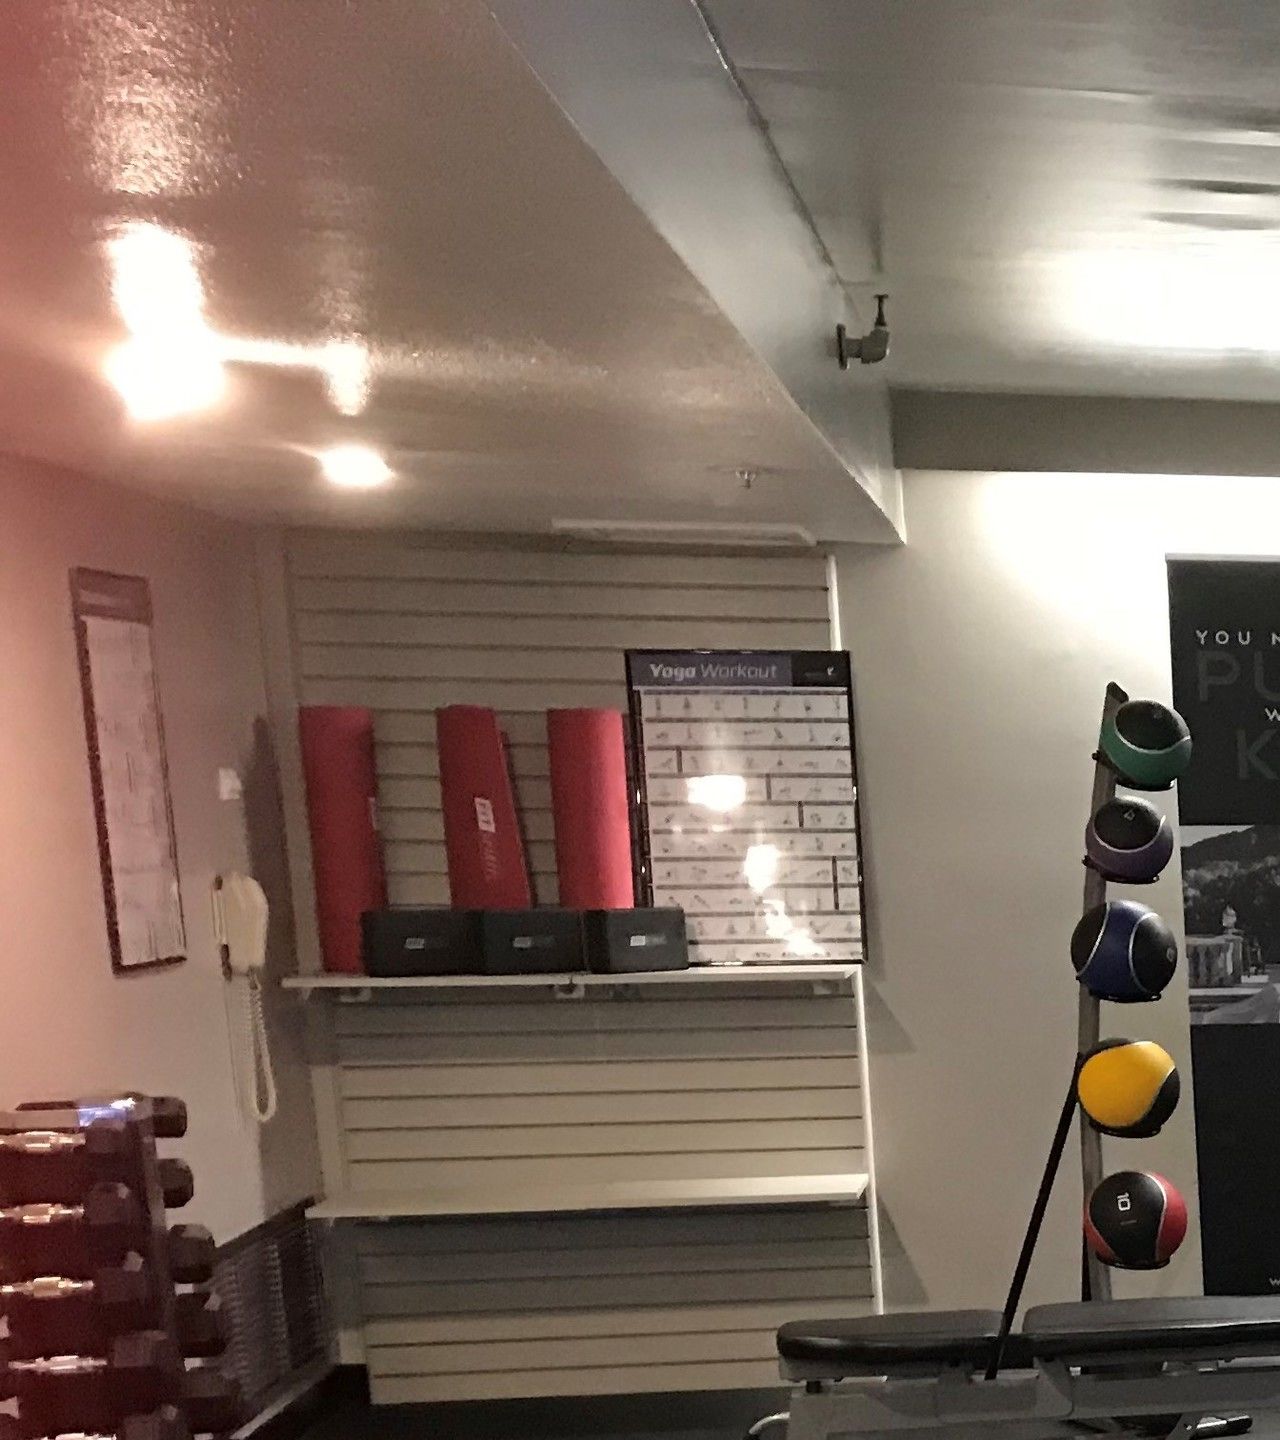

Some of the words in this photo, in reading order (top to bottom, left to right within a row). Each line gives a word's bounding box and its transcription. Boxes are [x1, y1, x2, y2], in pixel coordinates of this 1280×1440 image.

[1195, 630, 1251, 645] YOU
[650, 664, 696, 681] Yoga
[700, 663, 777, 678] Workout
[1116, 1192, 1131, 1211] 10
